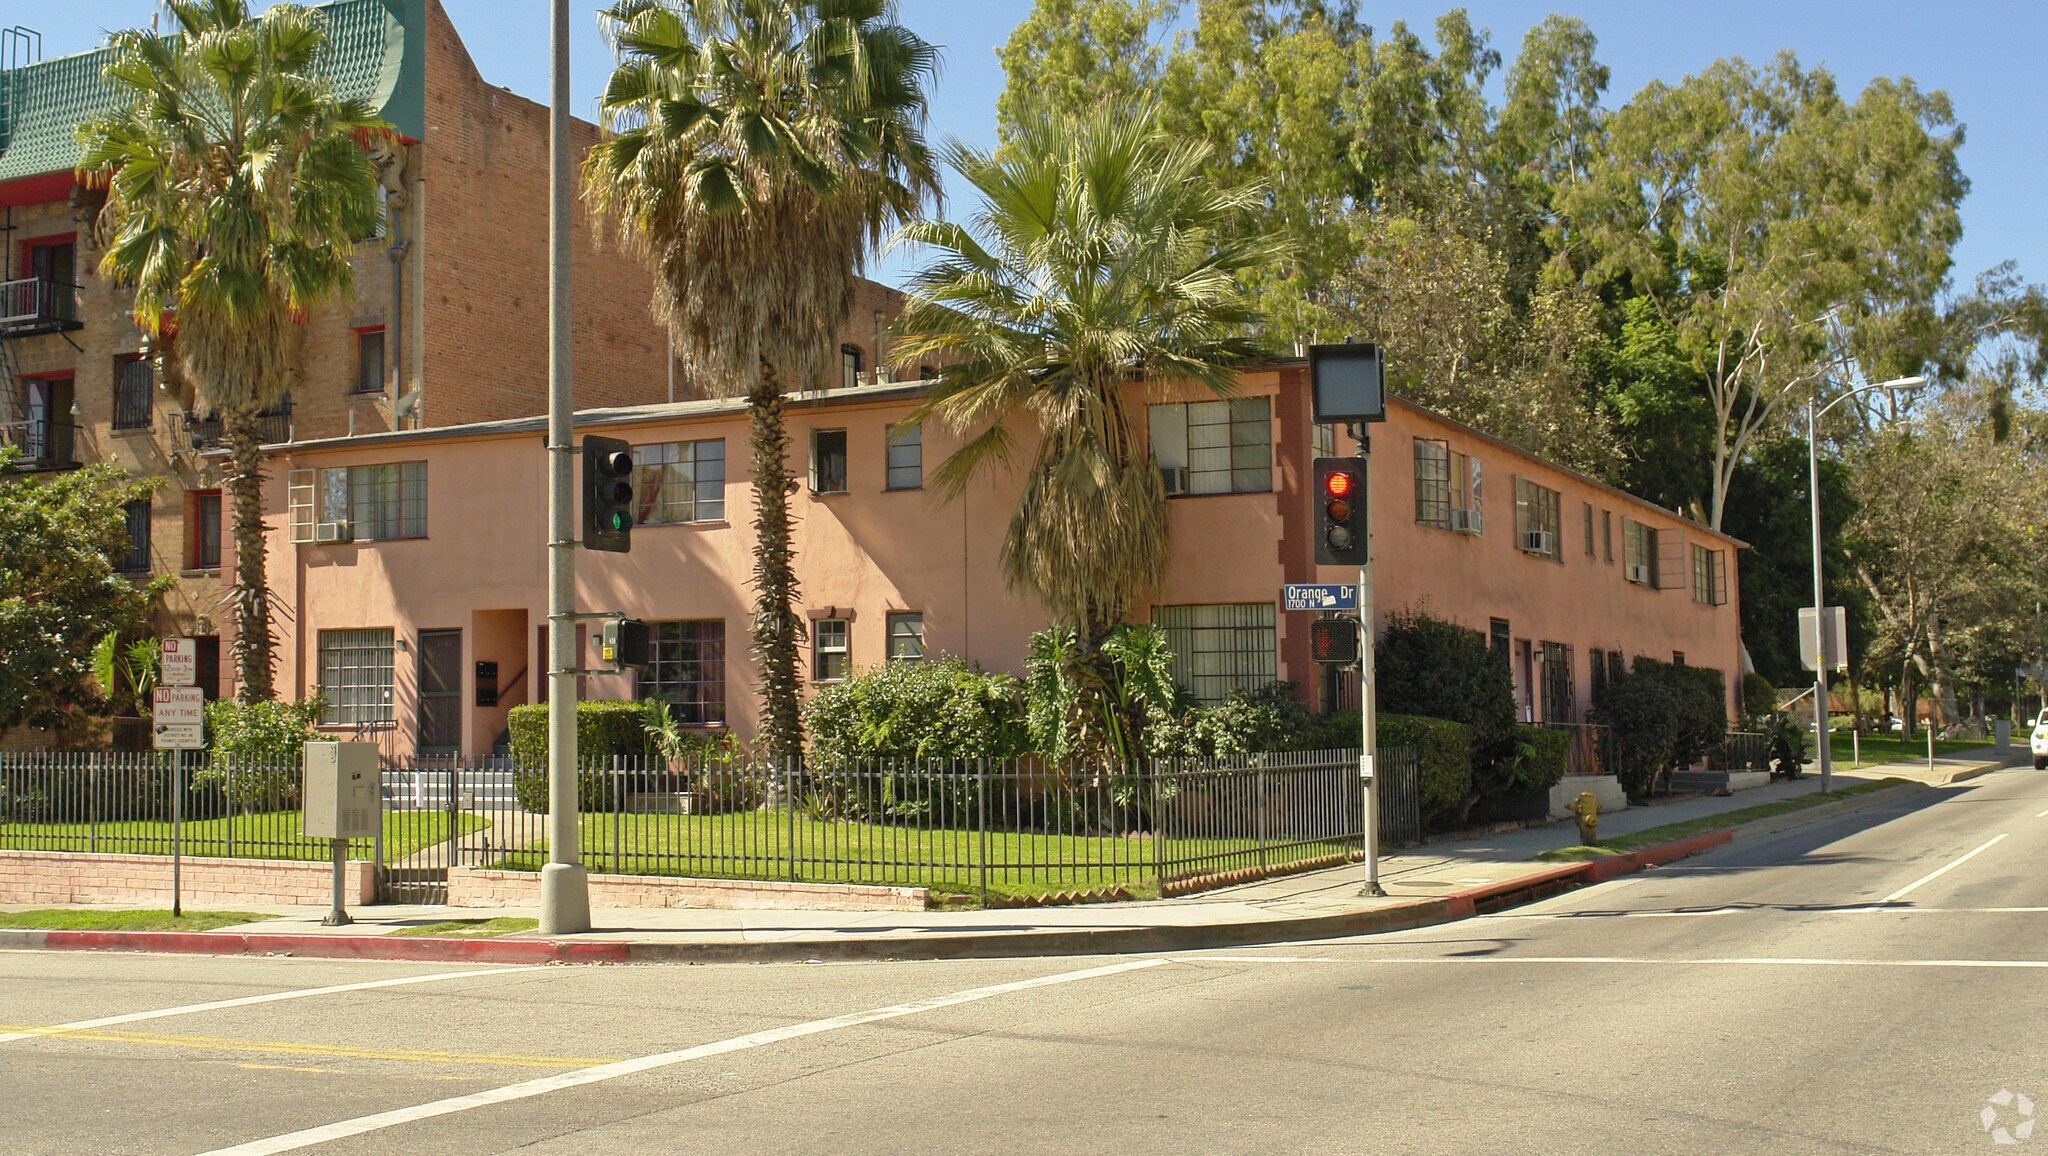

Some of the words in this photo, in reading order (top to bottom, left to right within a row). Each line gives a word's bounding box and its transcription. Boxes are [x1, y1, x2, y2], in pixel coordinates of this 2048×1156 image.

[1288, 586, 1328, 603] Orange
[1340, 586, 1354, 599] Dr
[1288, 599, 1306, 608] 1700
[1309, 599, 1315, 608] N
[165, 640, 177, 651] NO
[165, 655, 193, 663] PARKING
[155, 689, 170, 702] NO
[172, 694, 200, 703] PARKING
